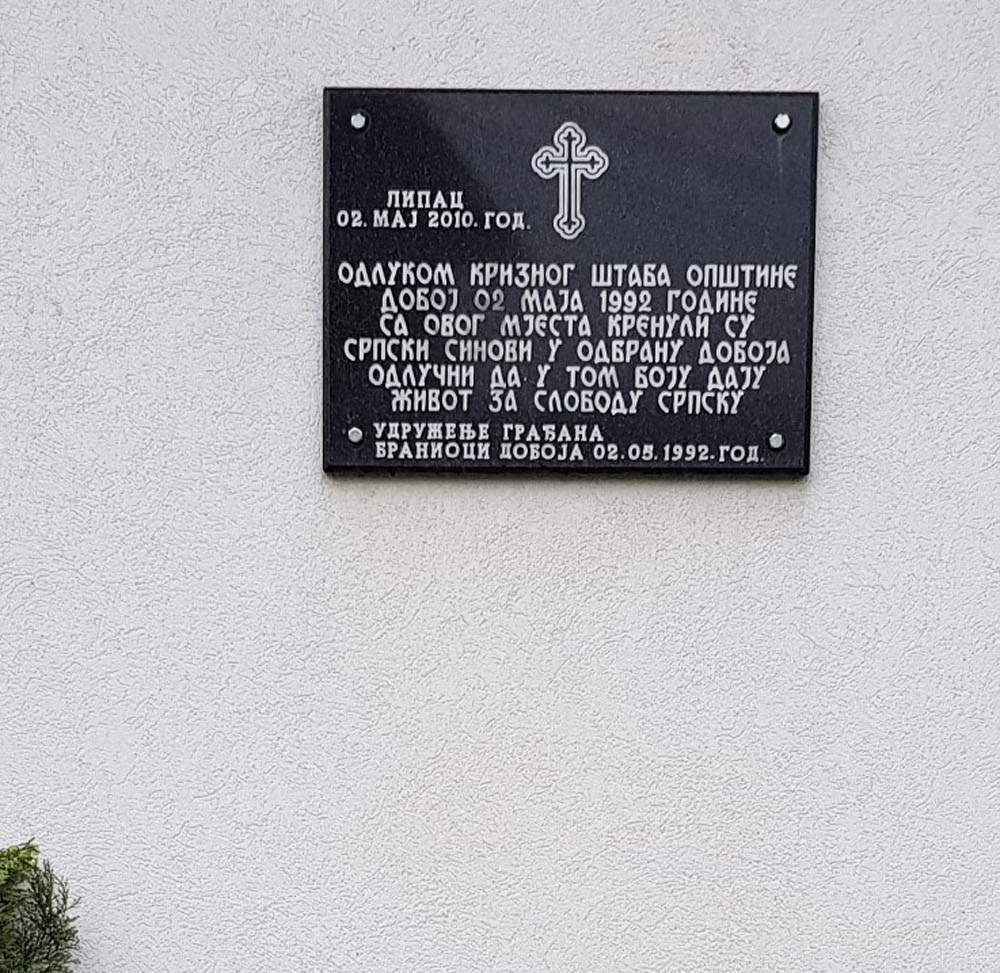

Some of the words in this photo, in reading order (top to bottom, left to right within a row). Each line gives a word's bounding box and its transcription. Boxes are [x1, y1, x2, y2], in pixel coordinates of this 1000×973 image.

[387, 190, 464, 210] ЛИПАЦ
[373, 210, 418, 228] МАЈ
[337, 261, 455, 288] ОДЛУКОМ
[470, 263, 576, 288] КРИЗНОГ
[591, 264, 671, 288] ШТАБА
[686, 264, 798, 289] ОПШТИНЕ
[380, 288, 458, 314] ДОБОЈ
[474, 289, 505, 312] 02
[520, 289, 584, 312] МАЈА
[599, 290, 652, 313] 1992
[667, 290, 758, 315] ГОДИНЕ
[379, 313, 409, 337] СА
[423, 314, 486, 337] ОВОГ
[500, 314, 592, 338] МЈЕСТА
[607, 314, 710, 338] КРЕНУЛИ
[724, 314, 756, 339] СУ
[343, 338, 429, 362] СРПСКИ
[444, 339, 532, 362] СИНОВИ
[548, 339, 563, 362] У
[577, 339, 684, 365] ОДБРАНУ
[698, 340, 790, 365] ДОБОЈА
[368, 363, 475, 389] ОДЛУЧНИ
[490, 365, 521, 389] ДА
[536, 364, 551, 388] У
[565, 366, 620, 389] ТОМ
[634, 365, 693, 389] БОЈУ
[706, 365, 767, 391] ДАЈУ
[391, 389, 473, 412] ЖИВОТ
[488, 390, 518, 413] ЗА
[533, 390, 644, 415] СЛОБОДУ
[657, 390, 745, 415] СРПСКУ
[373, 423, 490, 441] УДРУЖЕЊЕ
[502, 424, 604, 442] ГРАЂАНА
[375, 442, 491, 461] БРАНИОЦИ
[499, 443, 584, 461] ДОБОЈА
